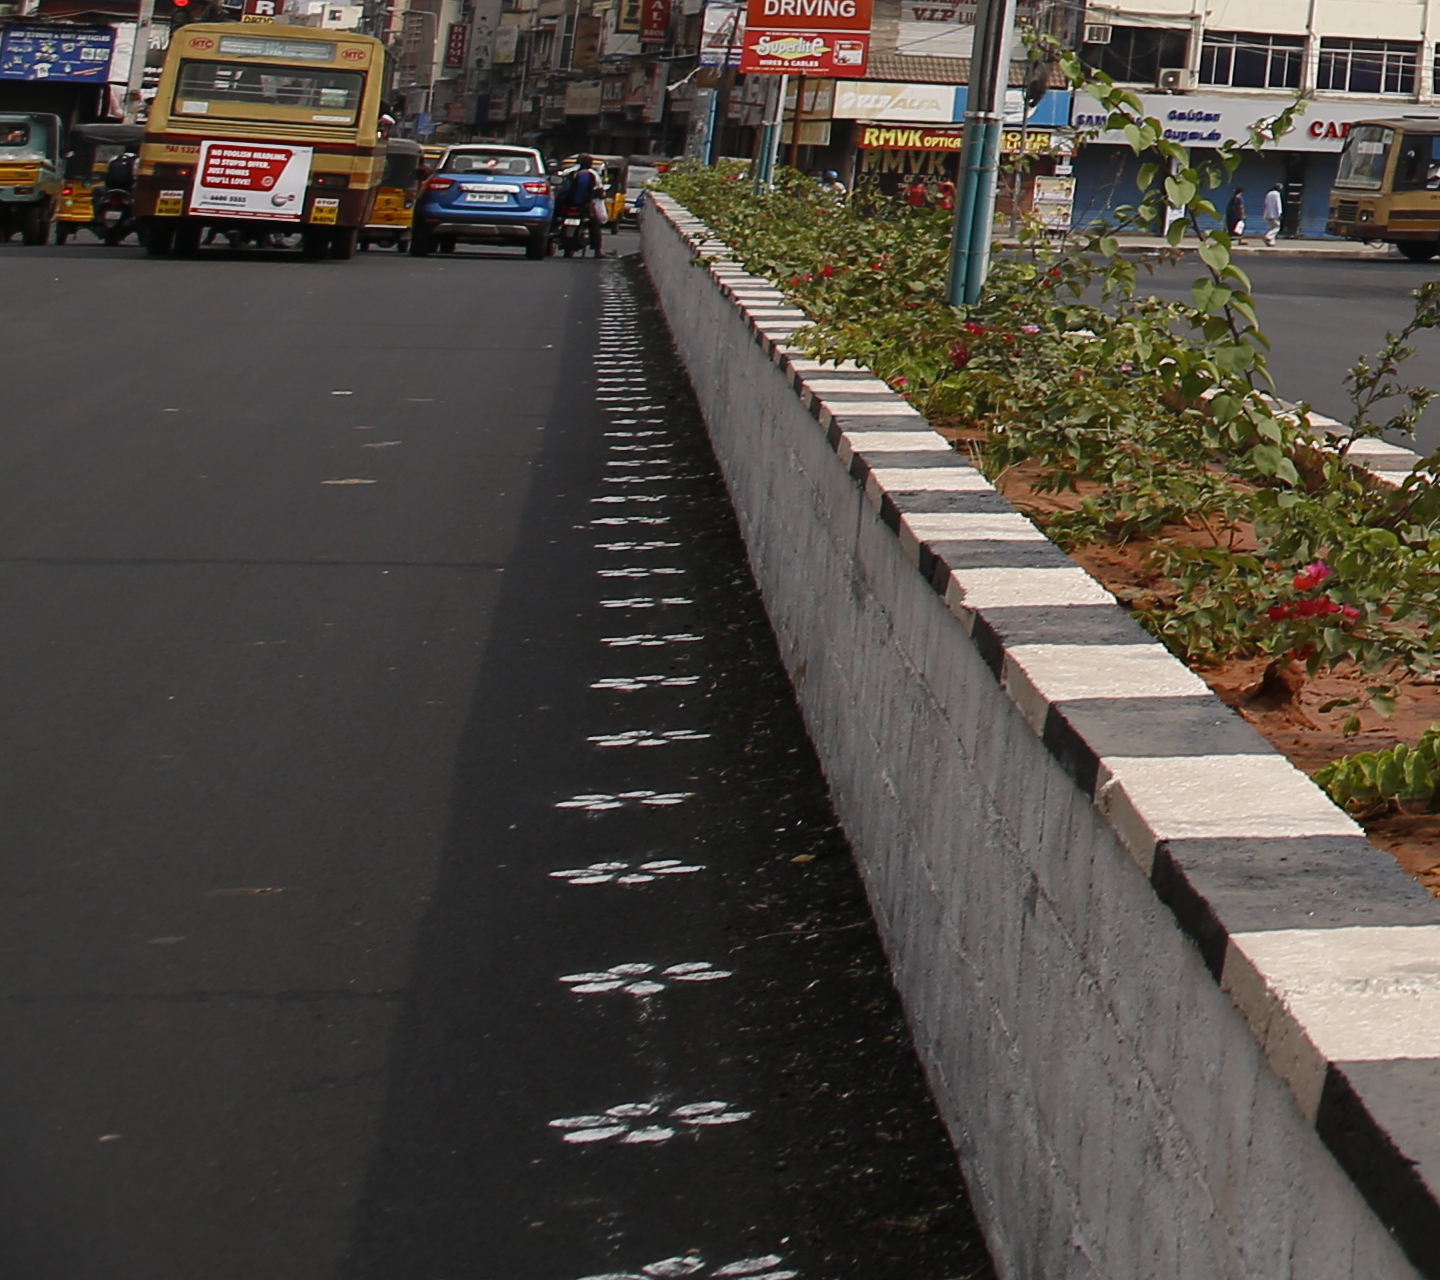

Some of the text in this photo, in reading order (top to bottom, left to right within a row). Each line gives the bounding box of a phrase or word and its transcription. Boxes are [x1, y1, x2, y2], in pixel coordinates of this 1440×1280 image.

[190, 39, 213, 49] MTC
[450, 24, 463, 64] ROOMS
[756, 36, 825, 57] Superlite
[342, 49, 365, 60] MTC
[893, 99, 942, 111] ALFA
[863, 128, 923, 147] RMVK
[861, 150, 947, 175] RMVK
